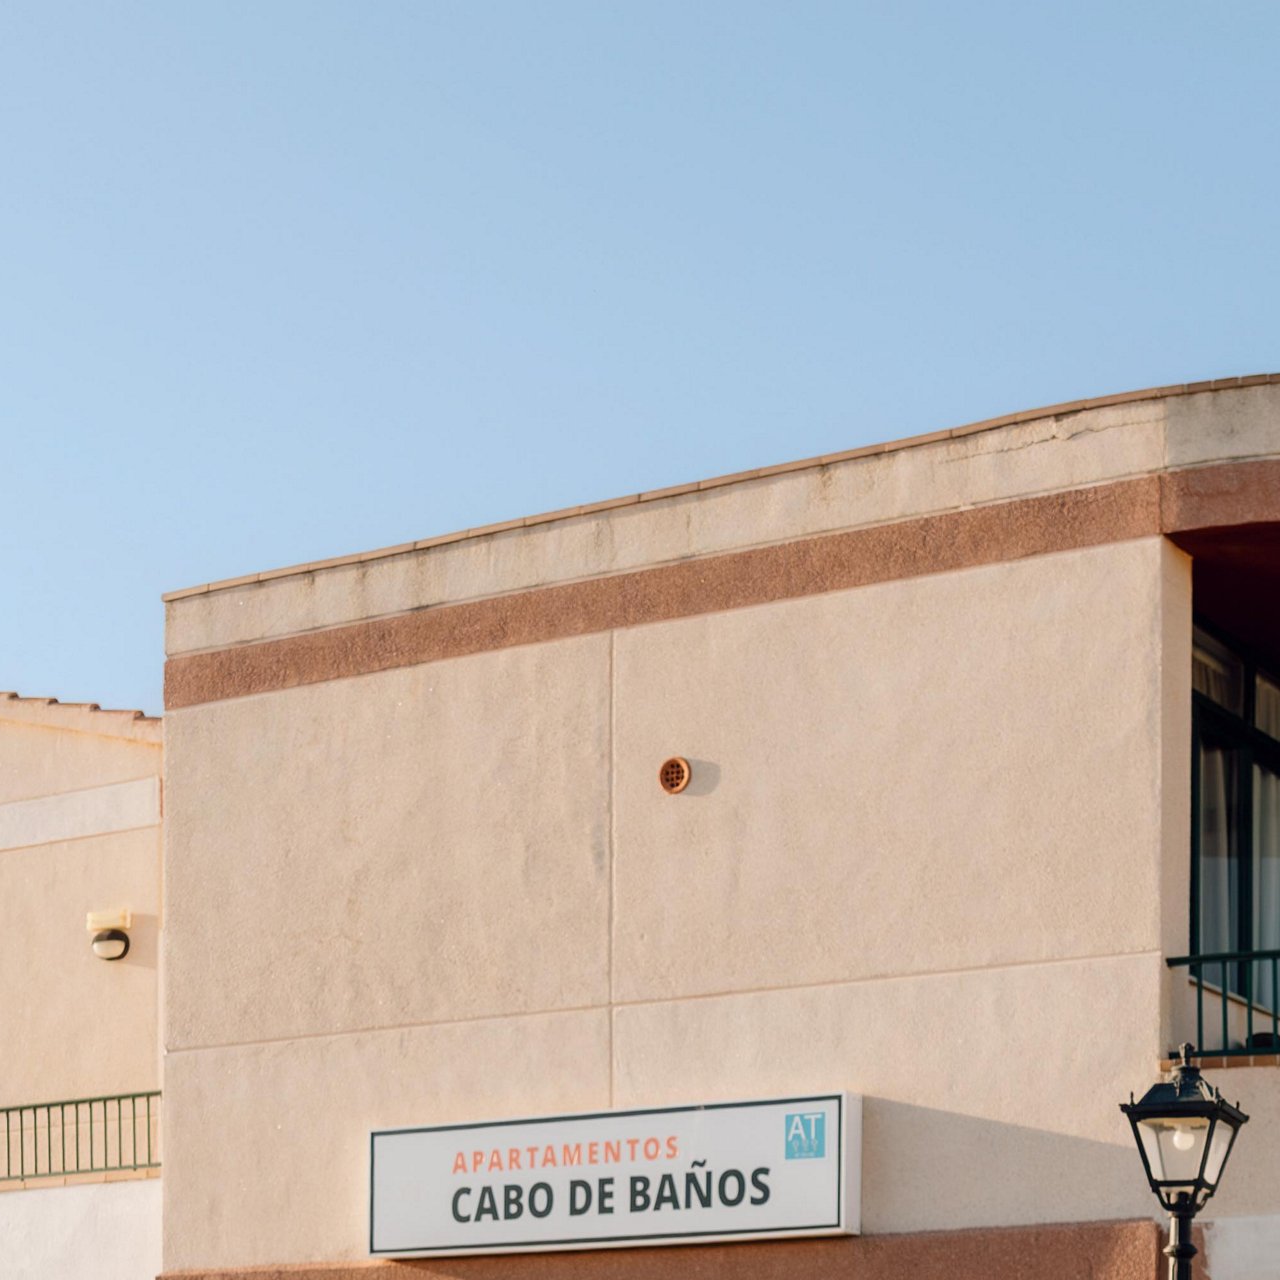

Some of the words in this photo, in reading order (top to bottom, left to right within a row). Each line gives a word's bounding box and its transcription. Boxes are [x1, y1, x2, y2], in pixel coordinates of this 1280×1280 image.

[787, 1114, 823, 1142] AT
[452, 1135, 680, 1175] APARTAMENTOS
[451, 1181, 554, 1223] CABO
[569, 1176, 615, 1217] DE
[629, 1160, 772, 1213] BAÑOS
